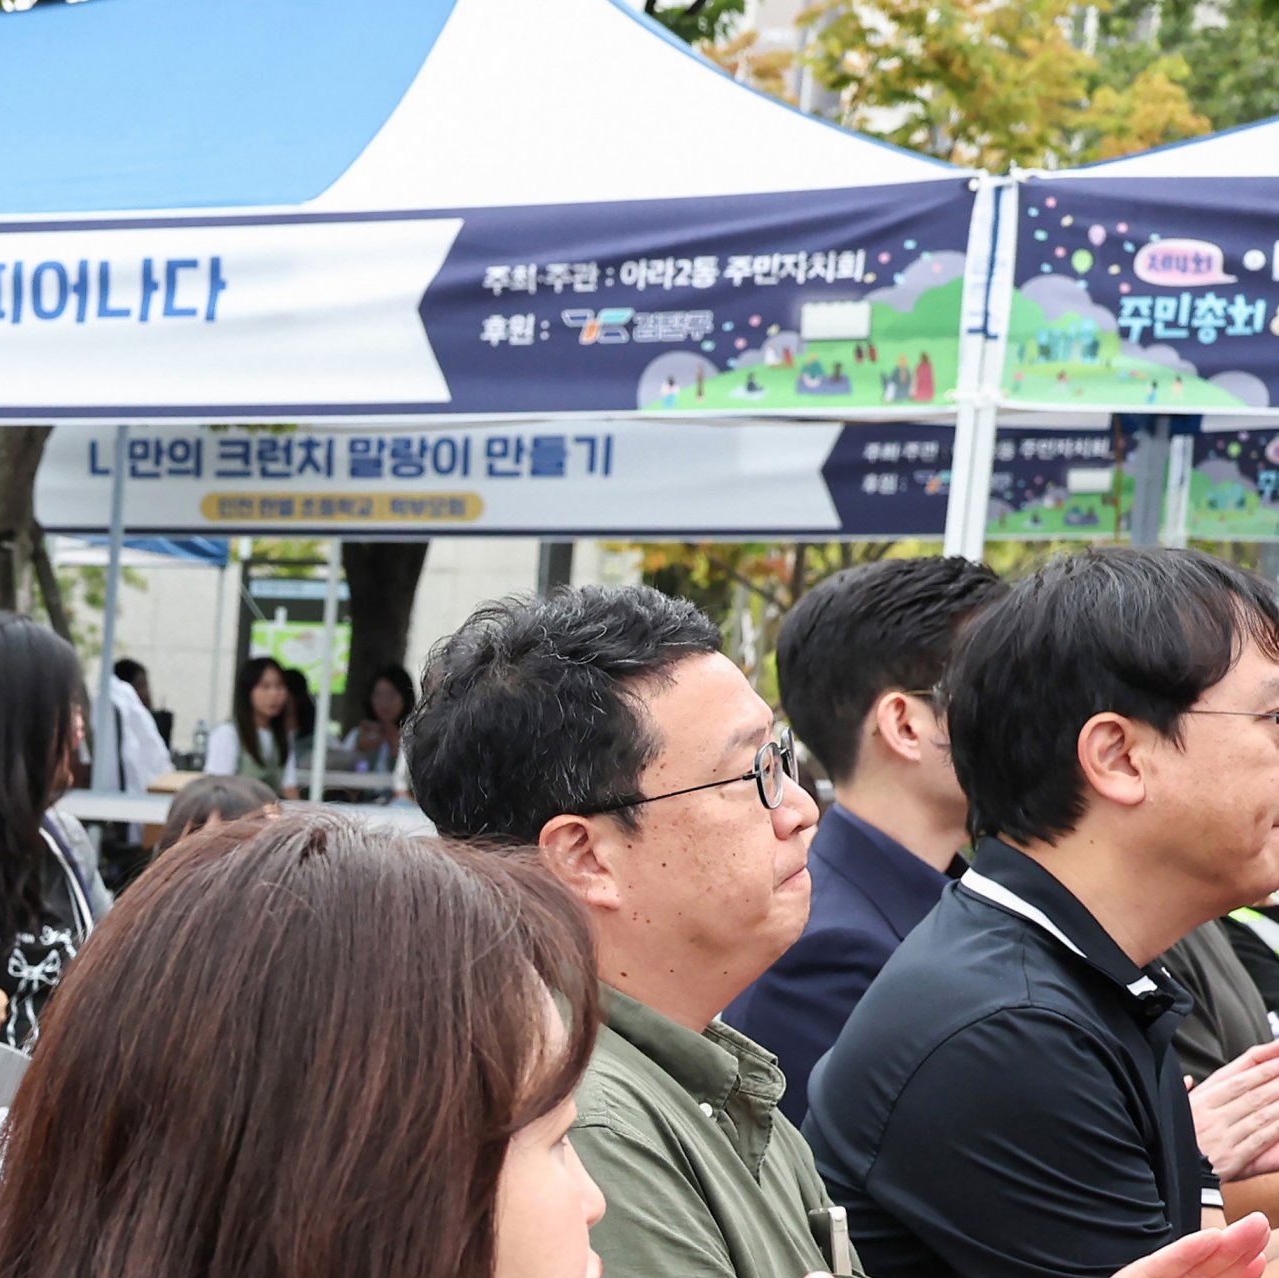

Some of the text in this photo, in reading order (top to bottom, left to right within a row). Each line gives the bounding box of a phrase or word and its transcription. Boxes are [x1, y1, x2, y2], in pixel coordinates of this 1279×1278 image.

[619, 256, 719, 292] 아라2동
[723, 249, 867, 288] 주민자치회
[480, 312, 536, 347] 후원
[1117, 291, 1267, 344] 주민총회
[215, 436, 334, 478] 크런치
[348, 434, 471, 478] 말랑이
[486, 433, 615, 478] 만들기
